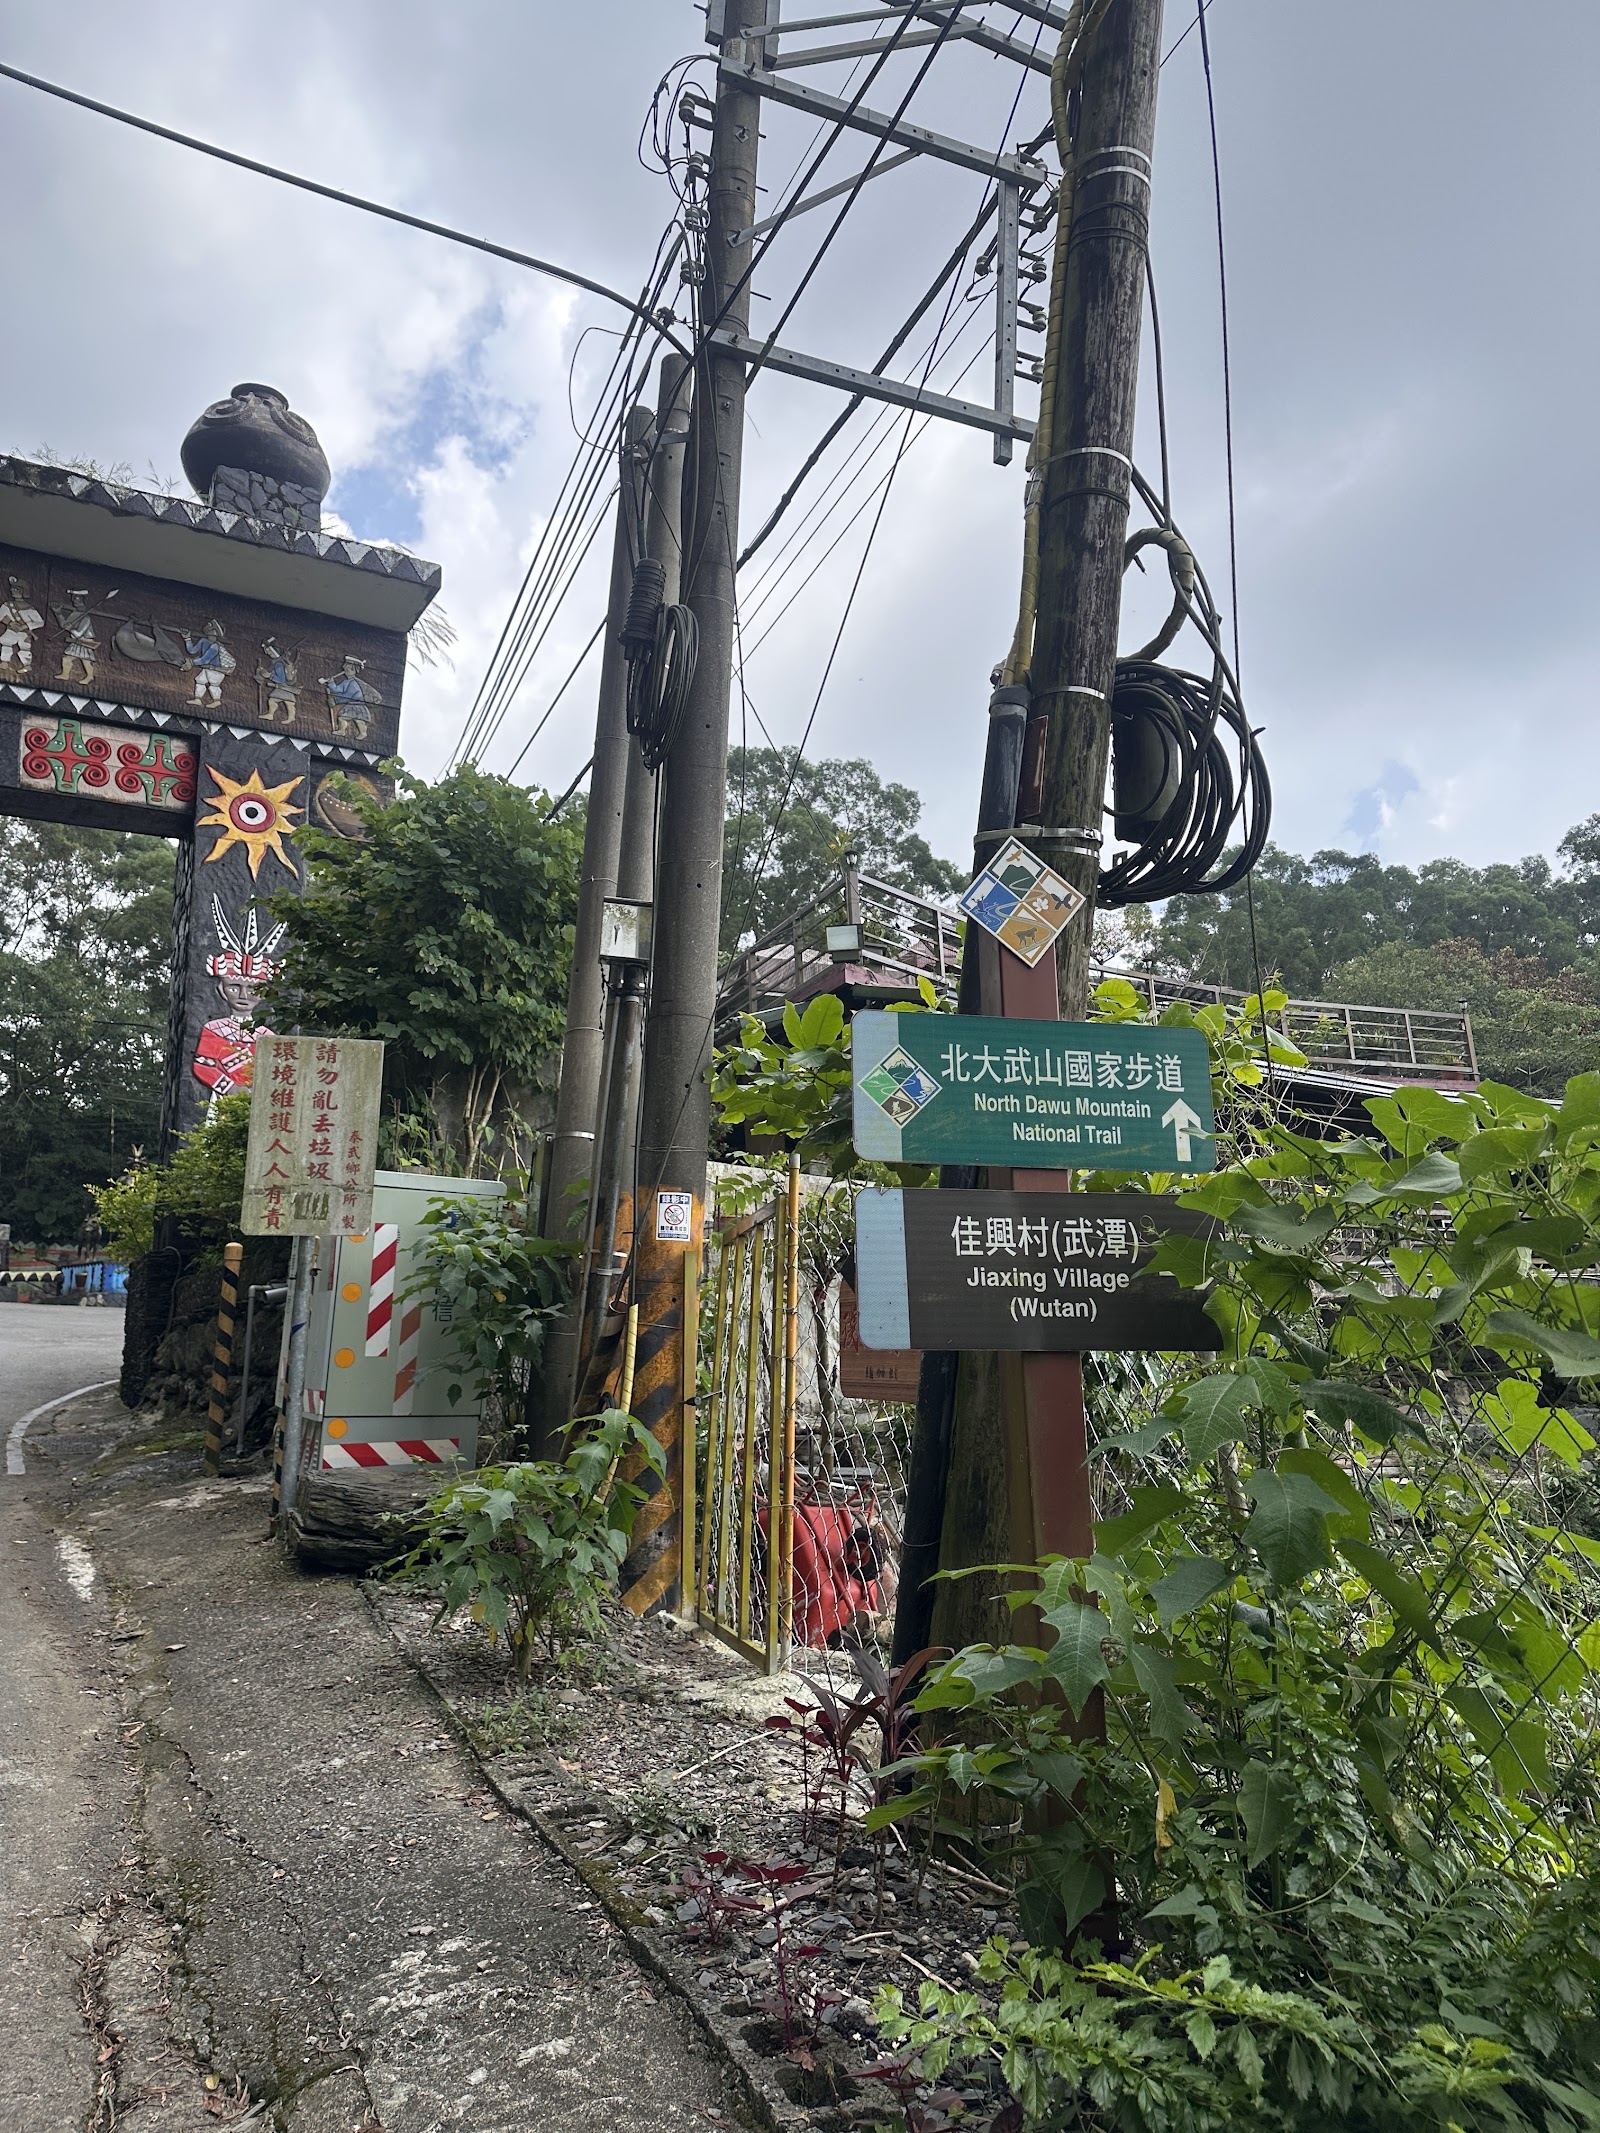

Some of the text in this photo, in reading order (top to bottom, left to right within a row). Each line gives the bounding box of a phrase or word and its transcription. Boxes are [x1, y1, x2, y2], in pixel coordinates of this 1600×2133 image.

[940, 1043, 1185, 1093] 北大武山國家步道
[307, 1043, 341, 1181] 請勿亂丟垃圾
[974, 1093, 1152, 1119] North Dawu Mountain
[260, 1041, 299, 1230] 環境維護人人有責
[1013, 1122, 1122, 1145] National Trail
[951, 1215, 1139, 1264] 佳興村(武潭)
[967, 1266, 1130, 1293] Jiaxing Village
[1010, 1298, 1098, 1323] (Wutan)
